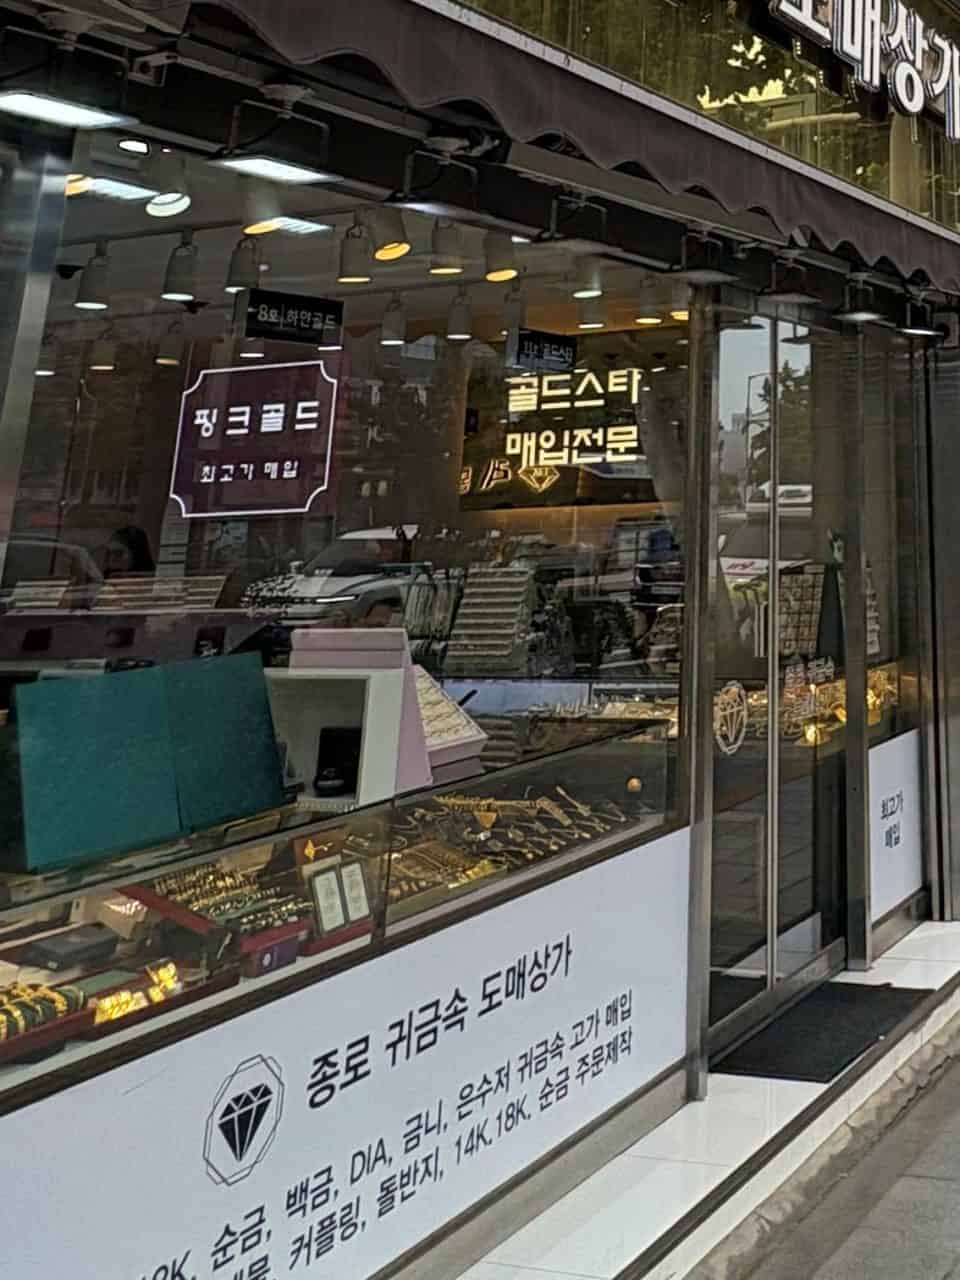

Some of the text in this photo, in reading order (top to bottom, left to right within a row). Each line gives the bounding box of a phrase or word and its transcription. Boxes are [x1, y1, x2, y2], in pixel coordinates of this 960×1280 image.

[508, 369, 642, 413] 골드스타
[194, 401, 320, 437] 핑크골드
[505, 424, 639, 467] 매입전문
[264, 461, 298, 480] 매입
[307, 933, 573, 1110] 종로 귀금속 도매상가
[210, 1205, 272, 1272] 순금,
[285, 1165, 339, 1218] 백금,
[350, 1137, 393, 1186] DIA,
[403, 1099, 448, 1155] 금니,
[456, 1059, 511, 1122] 은수저
[518, 1031, 566, 1083] 귀금속
[569, 1008, 600, 1051] 고가
[605, 988, 633, 1028] 매입
[289, 1195, 366, 1271] 커플링,
[376, 1146, 444, 1218] 돌반지,
[538, 1067, 570, 1112] 순금
[575, 1026, 633, 1086] 주문제작
